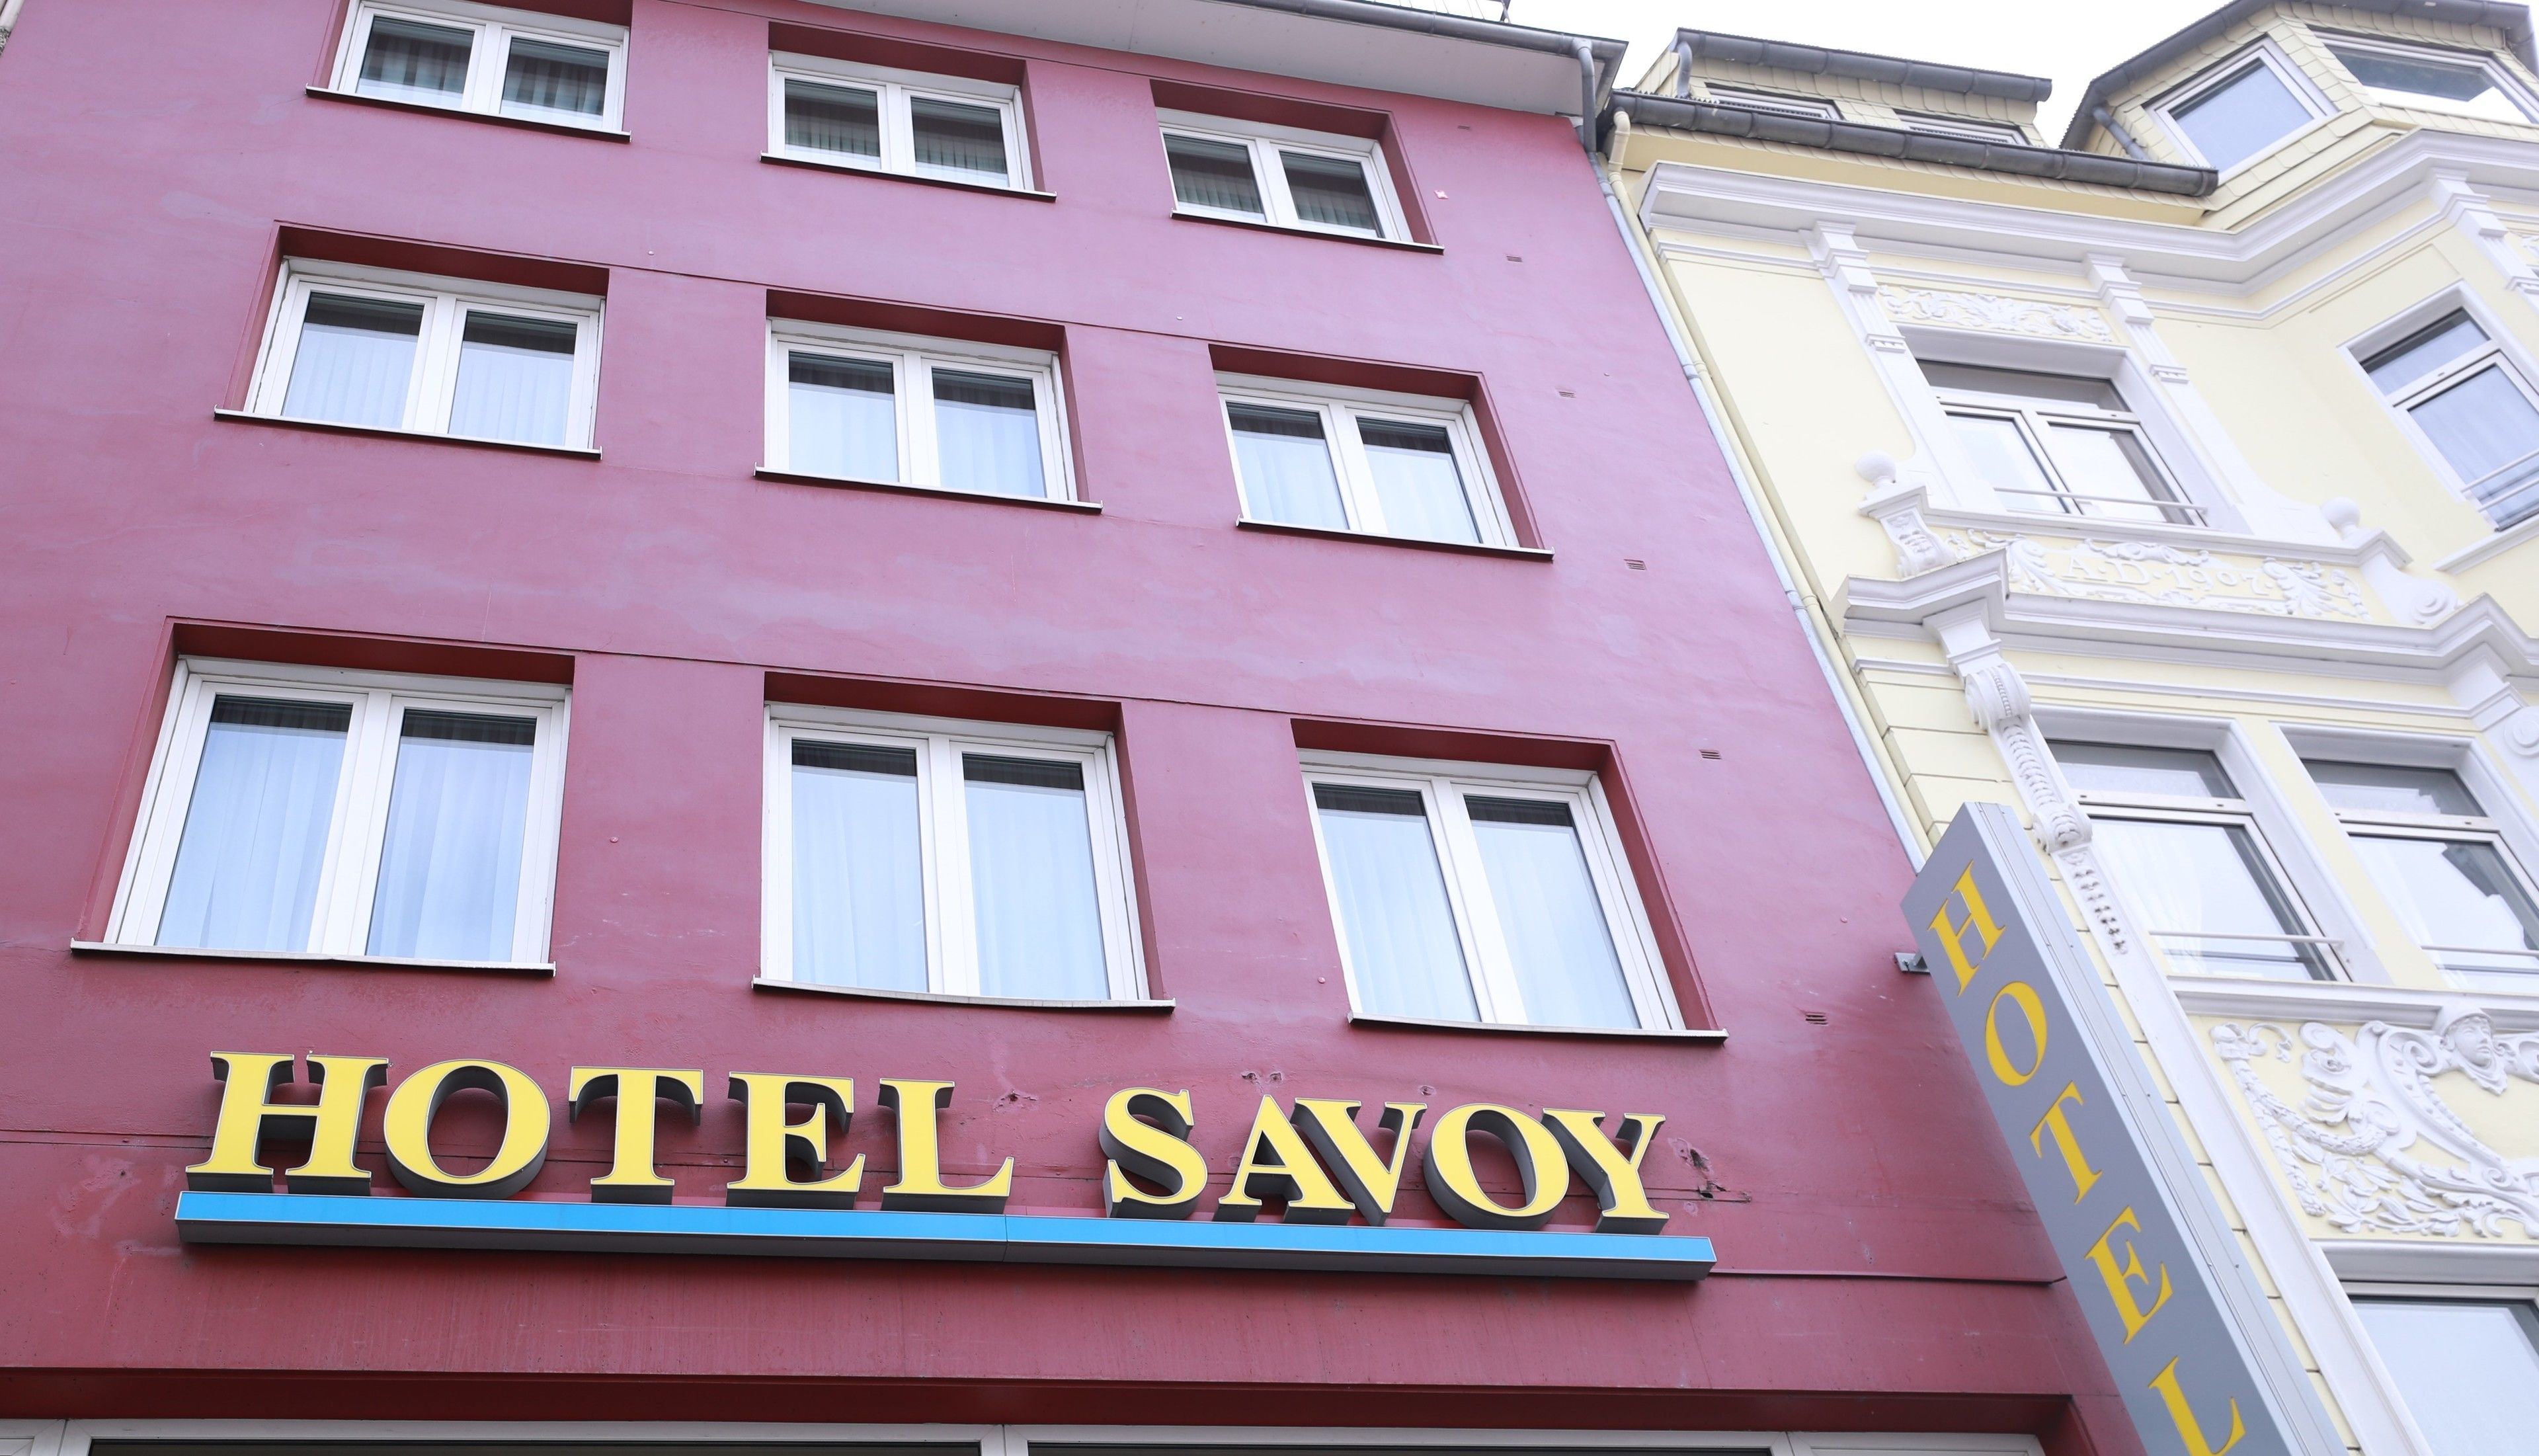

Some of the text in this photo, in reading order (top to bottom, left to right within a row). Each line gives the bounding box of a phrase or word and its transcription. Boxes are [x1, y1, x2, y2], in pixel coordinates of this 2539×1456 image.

[184, 1050, 1671, 1225] HOTEL SAVOY
[1928, 859, 2246, 1456] HOTEL
